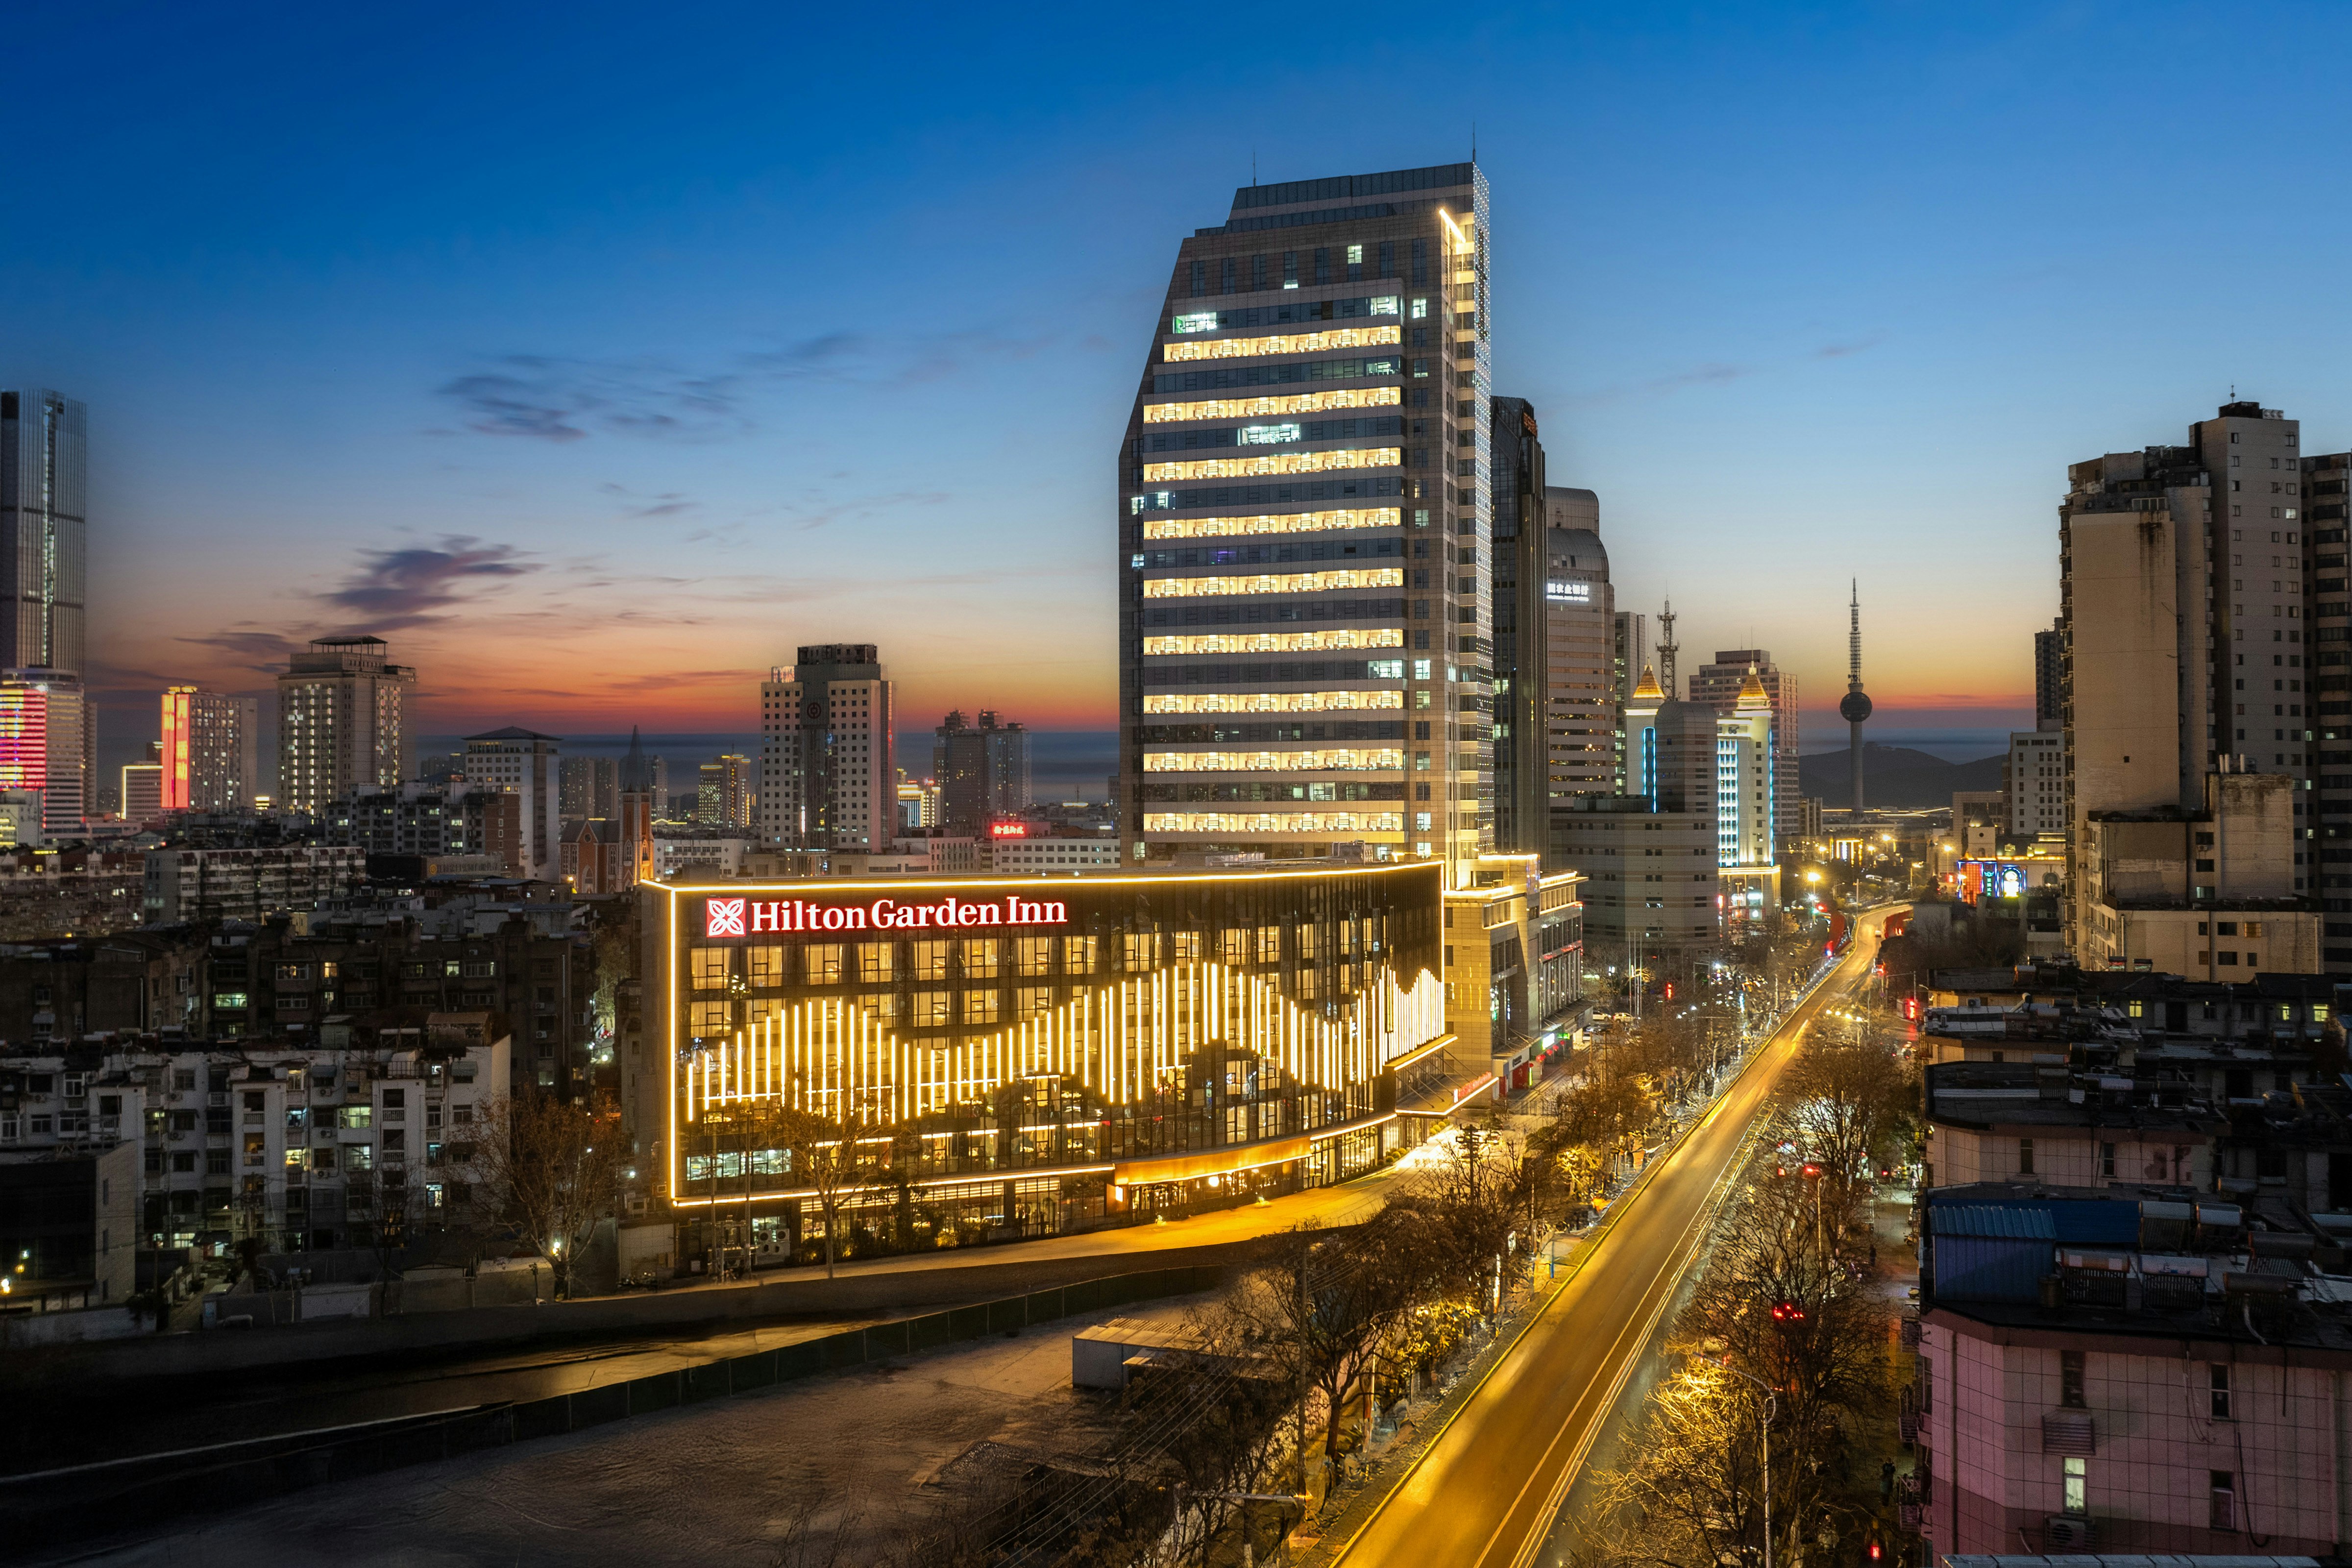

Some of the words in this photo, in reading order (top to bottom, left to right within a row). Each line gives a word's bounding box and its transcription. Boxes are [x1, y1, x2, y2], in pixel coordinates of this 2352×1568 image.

[752, 901, 867, 931] Hilton
[871, 898, 1002, 928] Garden
[1006, 896, 1067, 924] Inn
